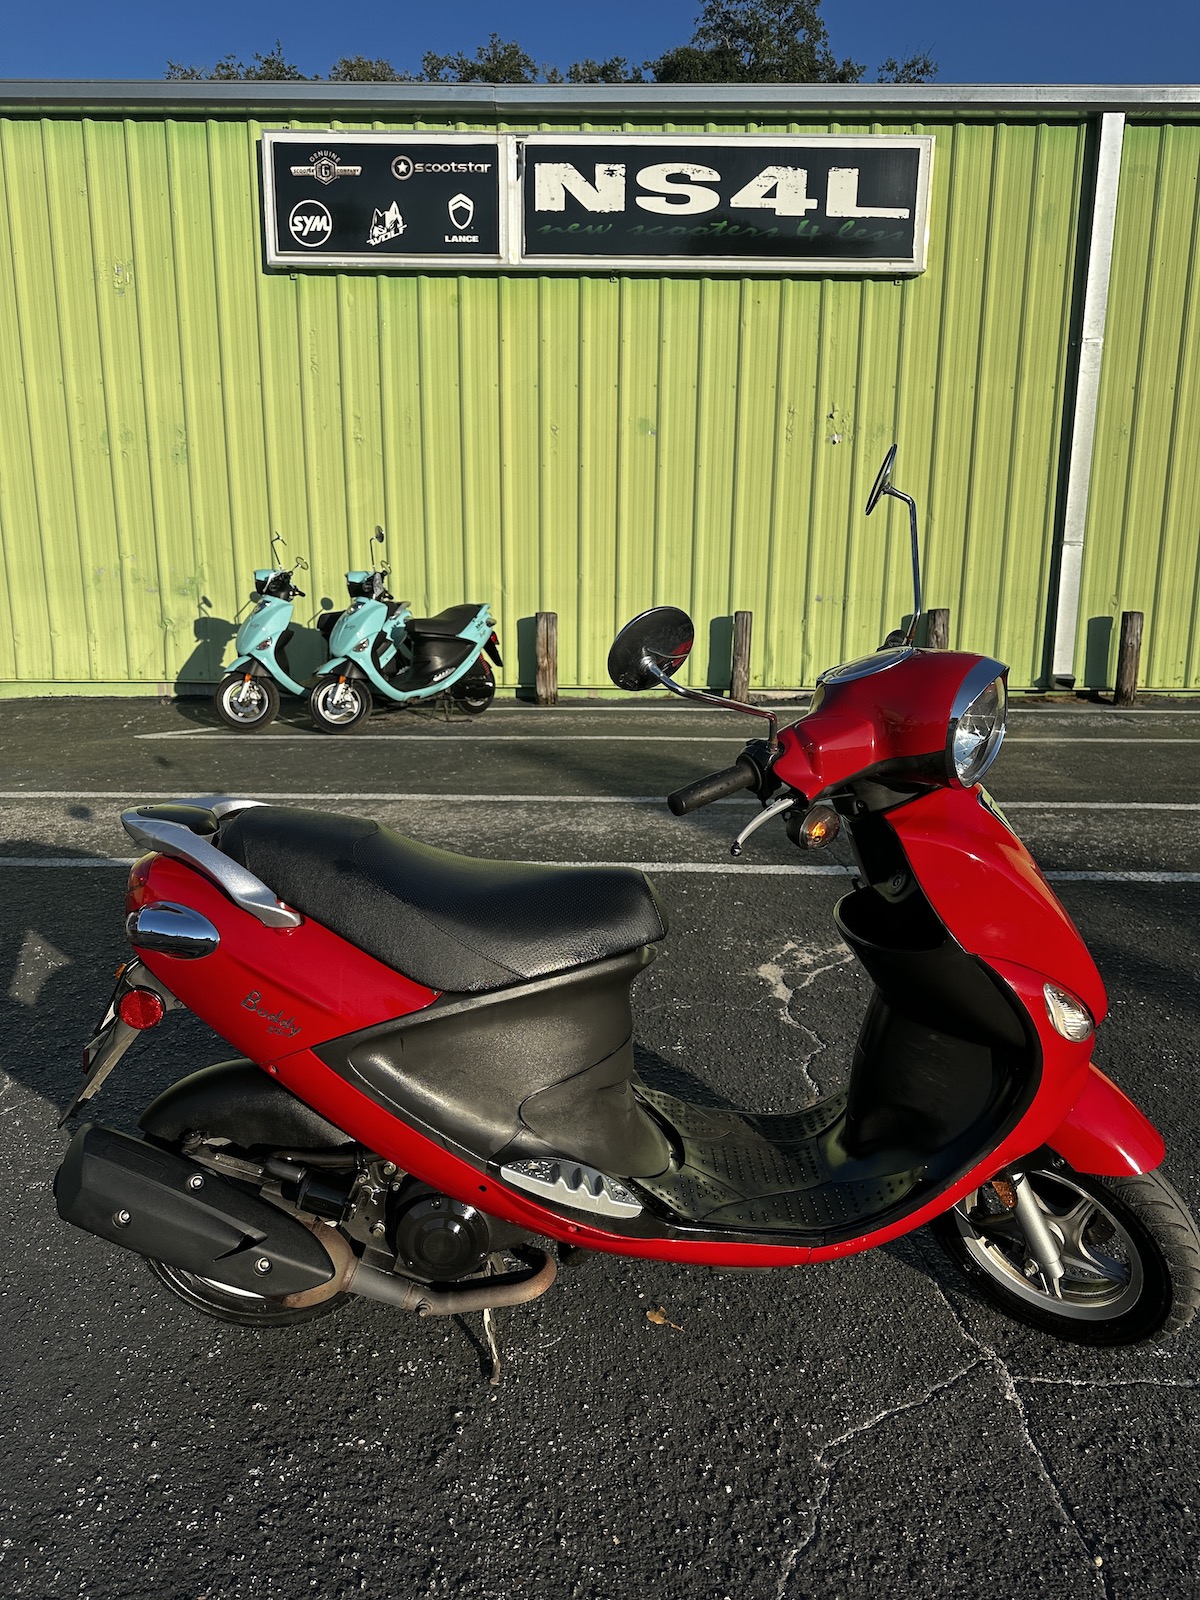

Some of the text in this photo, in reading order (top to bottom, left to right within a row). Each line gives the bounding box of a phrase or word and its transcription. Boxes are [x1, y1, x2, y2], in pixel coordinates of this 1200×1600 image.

[309, 150, 341, 163] GENUINE
[414, 161, 491, 173] scootstar
[321, 165, 330, 177] G
[534, 162, 910, 219] NS4L
[292, 215, 330, 236] SYM
[366, 224, 407, 246] WOLF
[537, 219, 904, 241] new scooters 4 less
[445, 235, 479, 243] LANCE
[241, 990, 302, 1037] Buddy
